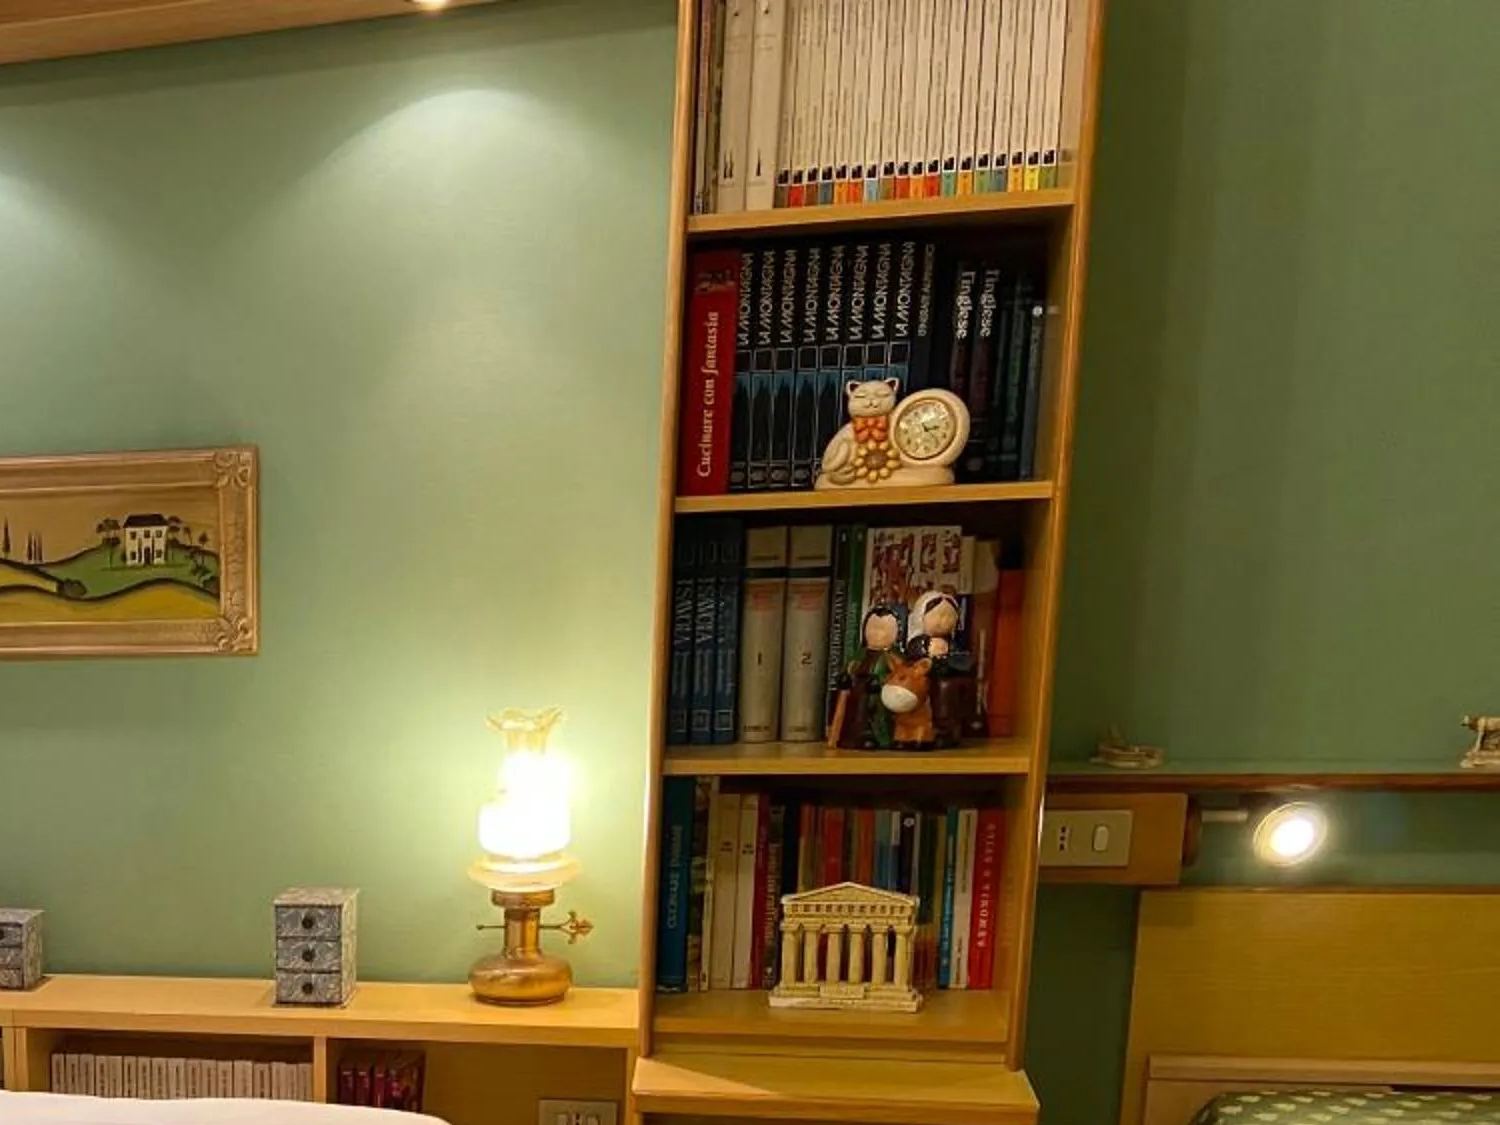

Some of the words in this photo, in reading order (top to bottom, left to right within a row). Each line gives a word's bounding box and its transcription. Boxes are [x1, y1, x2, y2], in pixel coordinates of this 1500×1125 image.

[758, 249, 776, 329] MONTAGNA
[780, 249, 798, 329] MONTAGNA
[804, 247, 821, 328] MONTAGNA
[826, 245, 845, 326] MONTAGNA
[850, 245, 869, 325] MONTAGNA
[872, 243, 892, 323] MONTAGNA
[896, 241, 916, 322] MONTAGNA
[702, 312, 720, 376] fantasia
[703, 379, 715, 405] con
[697, 410, 714, 477] Cucinare
[802, 652, 812, 665] 2
